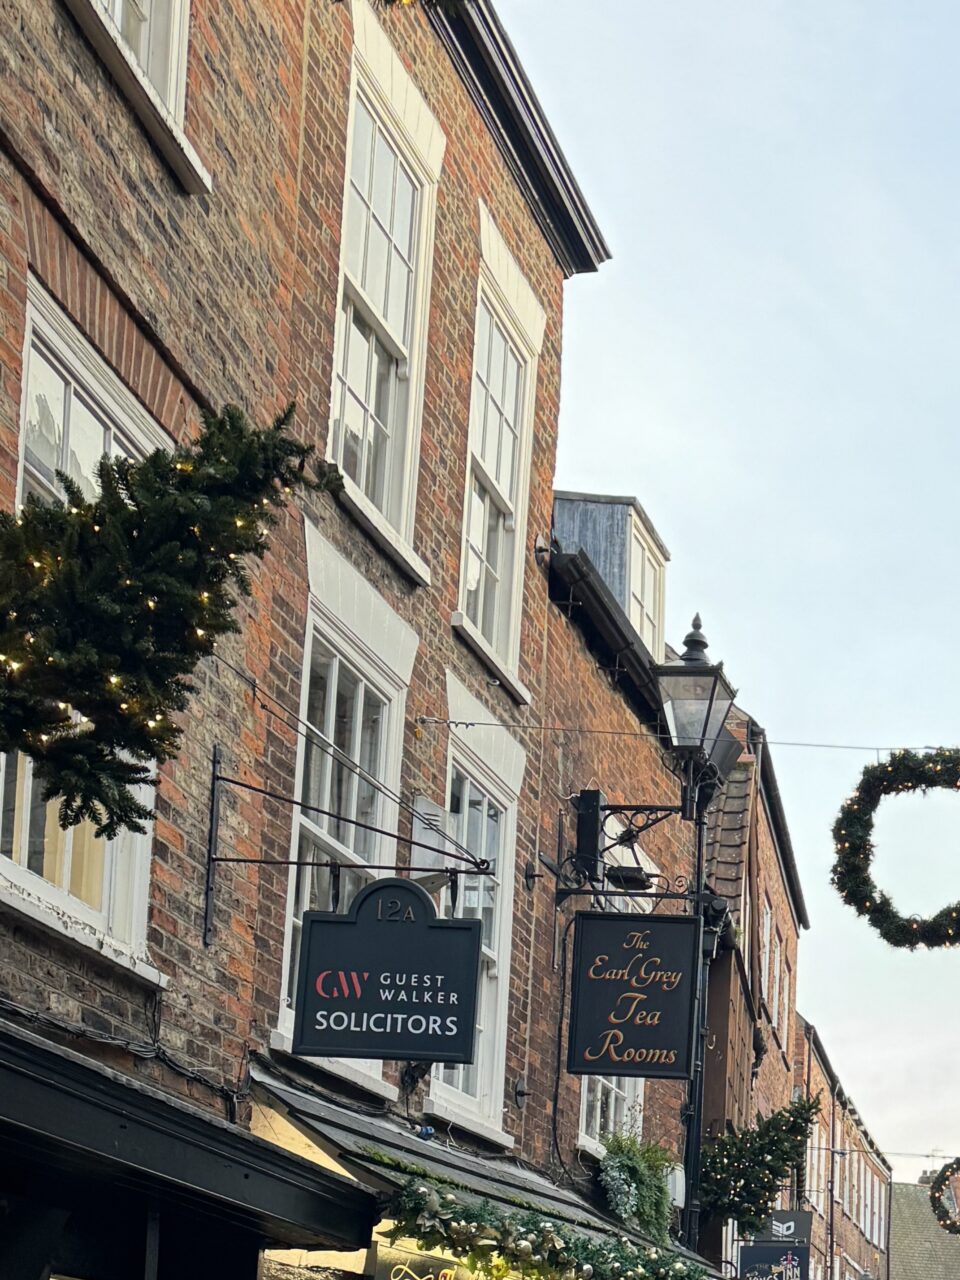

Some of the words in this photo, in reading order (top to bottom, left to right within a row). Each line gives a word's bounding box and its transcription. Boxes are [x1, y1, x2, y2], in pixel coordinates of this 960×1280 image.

[377, 899, 416, 922] 12A
[622, 930, 650, 949] The
[379, 972, 445, 987] GUEST
[588, 953, 642, 980] Earl
[630, 957, 682, 991] Grey
[379, 989, 459, 1004] WALKER
[608, 992, 662, 1026] Tea
[314, 1010, 458, 1036] SOLICITORS
[583, 1028, 678, 1063] Rooms
